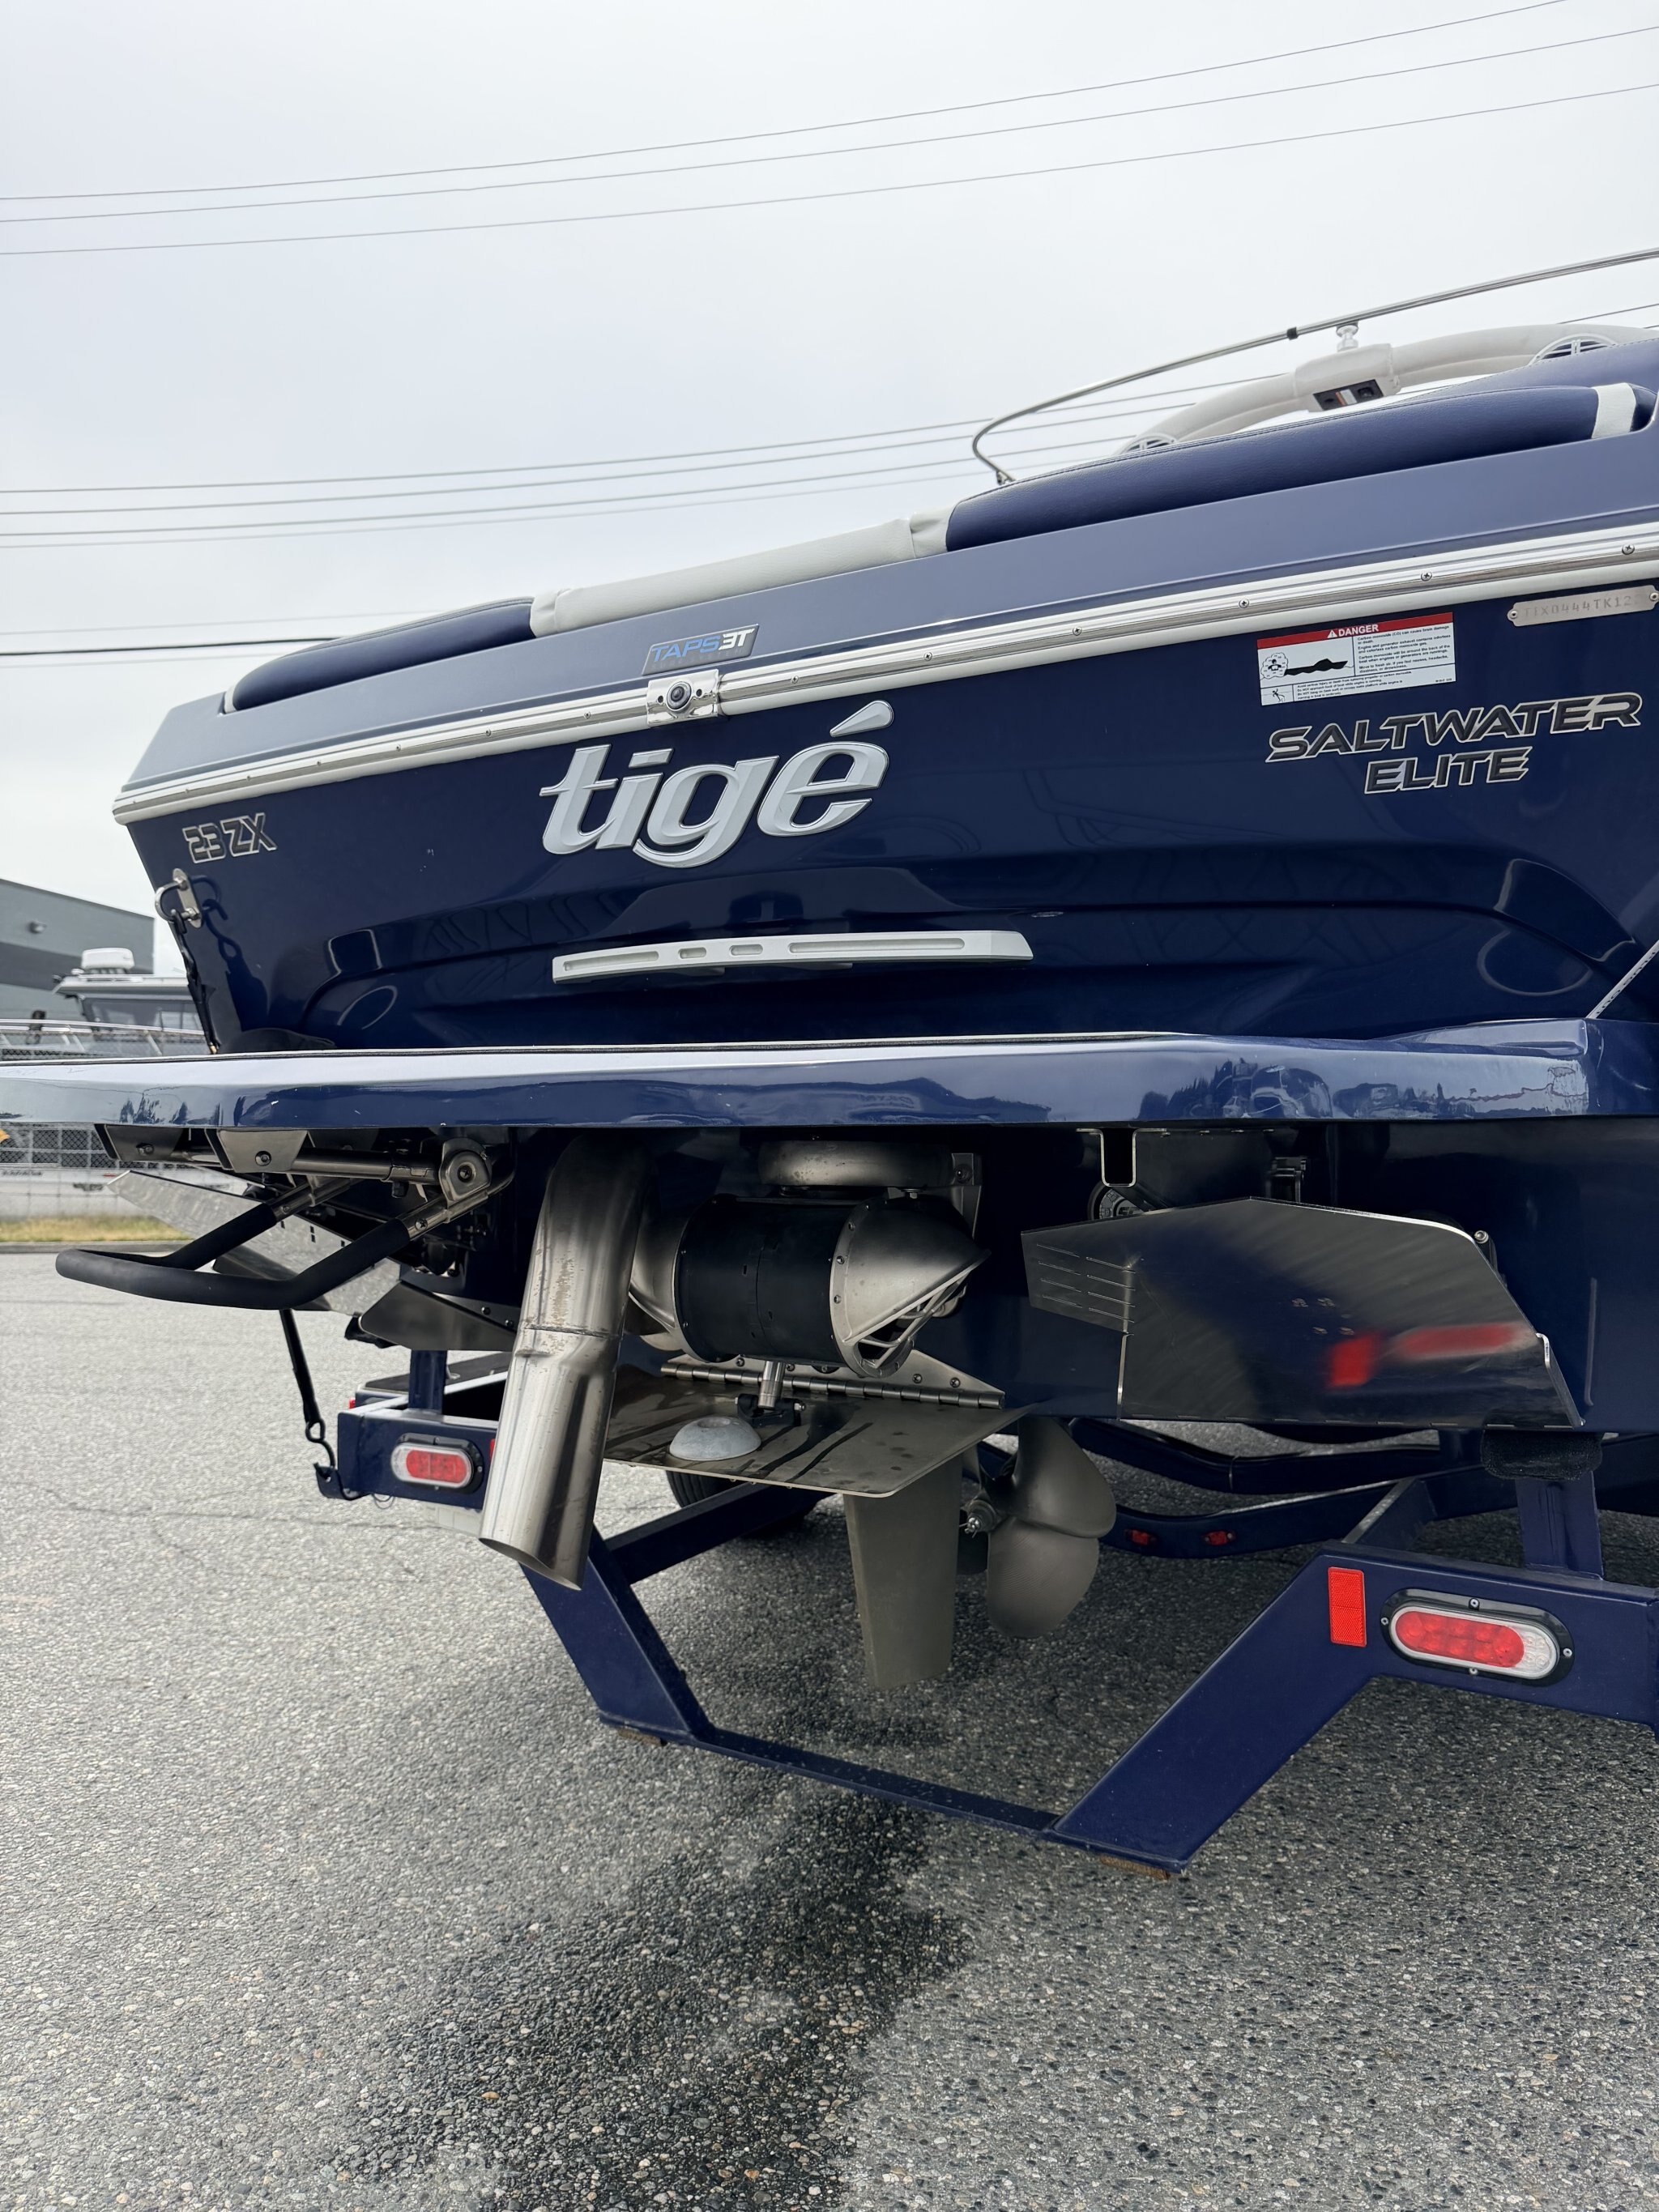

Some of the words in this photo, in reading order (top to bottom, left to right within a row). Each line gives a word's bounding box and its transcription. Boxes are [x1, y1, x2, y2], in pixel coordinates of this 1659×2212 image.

[1338, 624, 1379, 637] DANGER
[1265, 692, 1643, 763] SALTWATER
[539, 699, 895, 868] tigé
[1363, 746, 1533, 794] ELITE
[181, 822, 227, 864] 23
[220, 812, 278, 857] ZX
